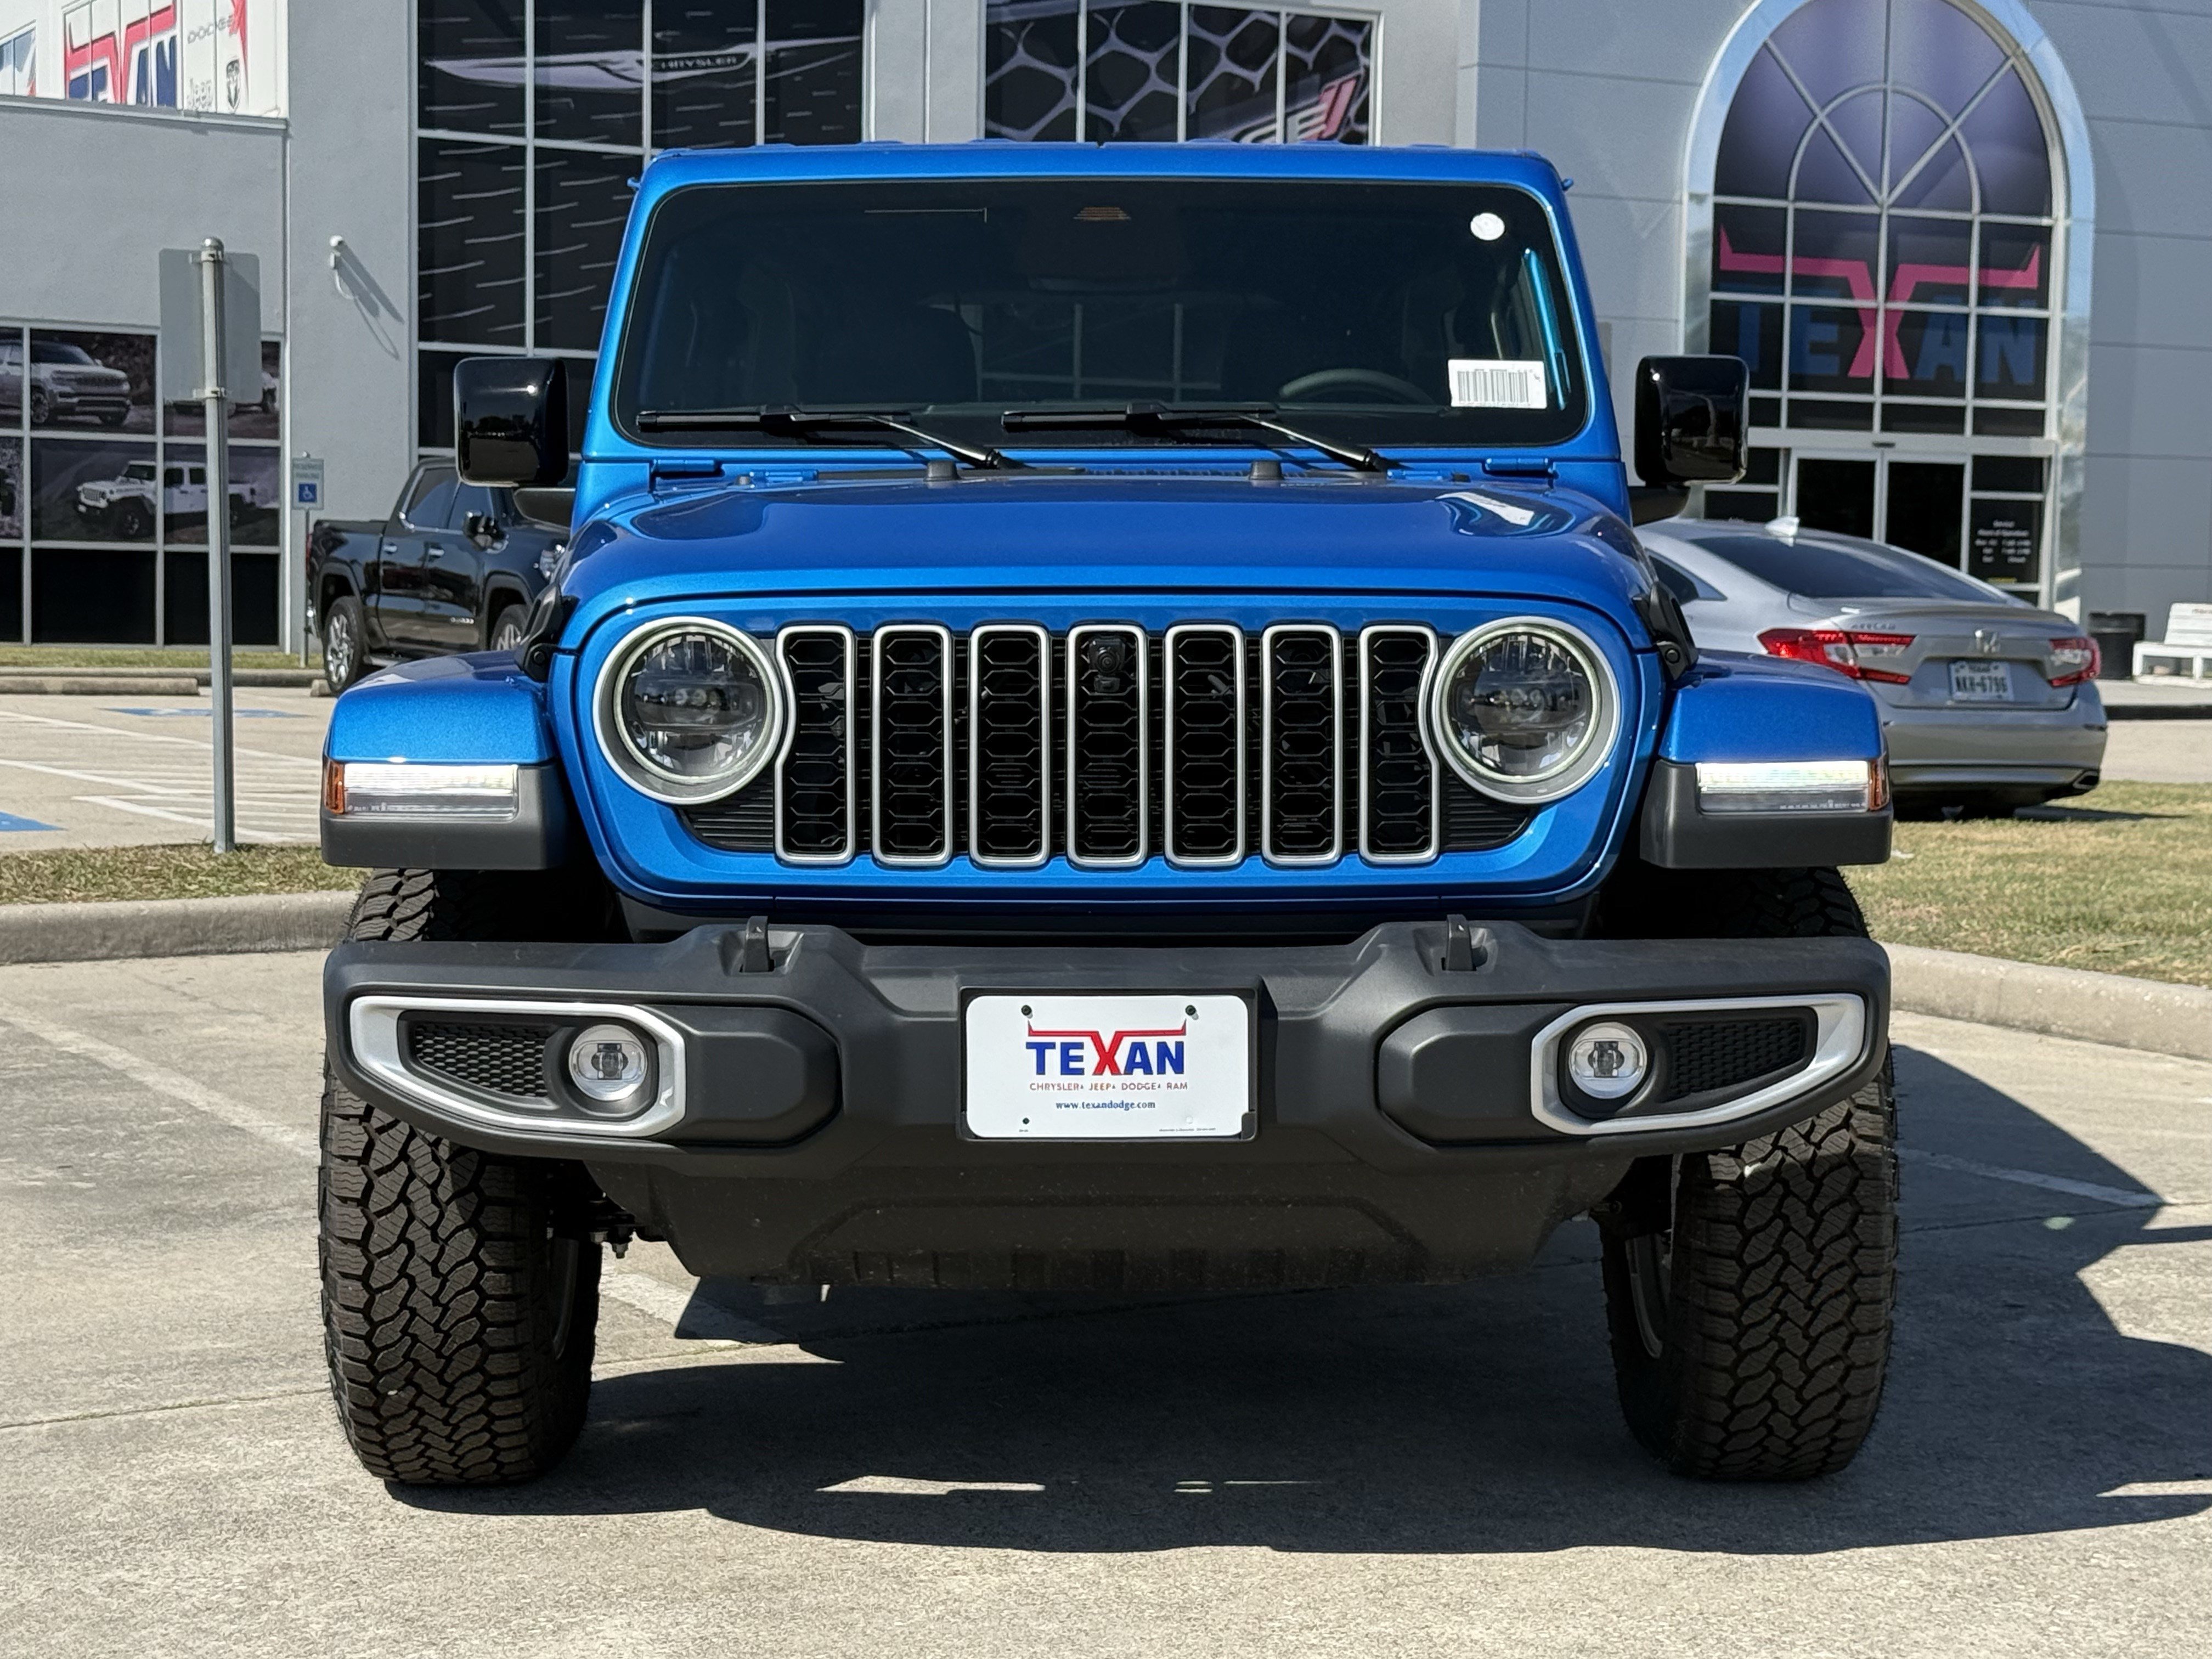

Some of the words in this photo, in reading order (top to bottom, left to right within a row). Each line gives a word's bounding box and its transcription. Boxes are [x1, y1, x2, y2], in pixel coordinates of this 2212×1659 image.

[658, 57, 737, 70] HRYSLER
[1718, 225, 2039, 384] TEXAN
[1025, 1019, 1187, 1075] TEXAN
[1030, 1082, 1080, 1091] CHRYSLER
[1088, 1082, 1111, 1091] JEEP
[1121, 1082, 1156, 1091] DODGE
[1166, 1081, 1188, 1090] RAM
[1056, 1099, 1156, 1111] www.texandodge.com
